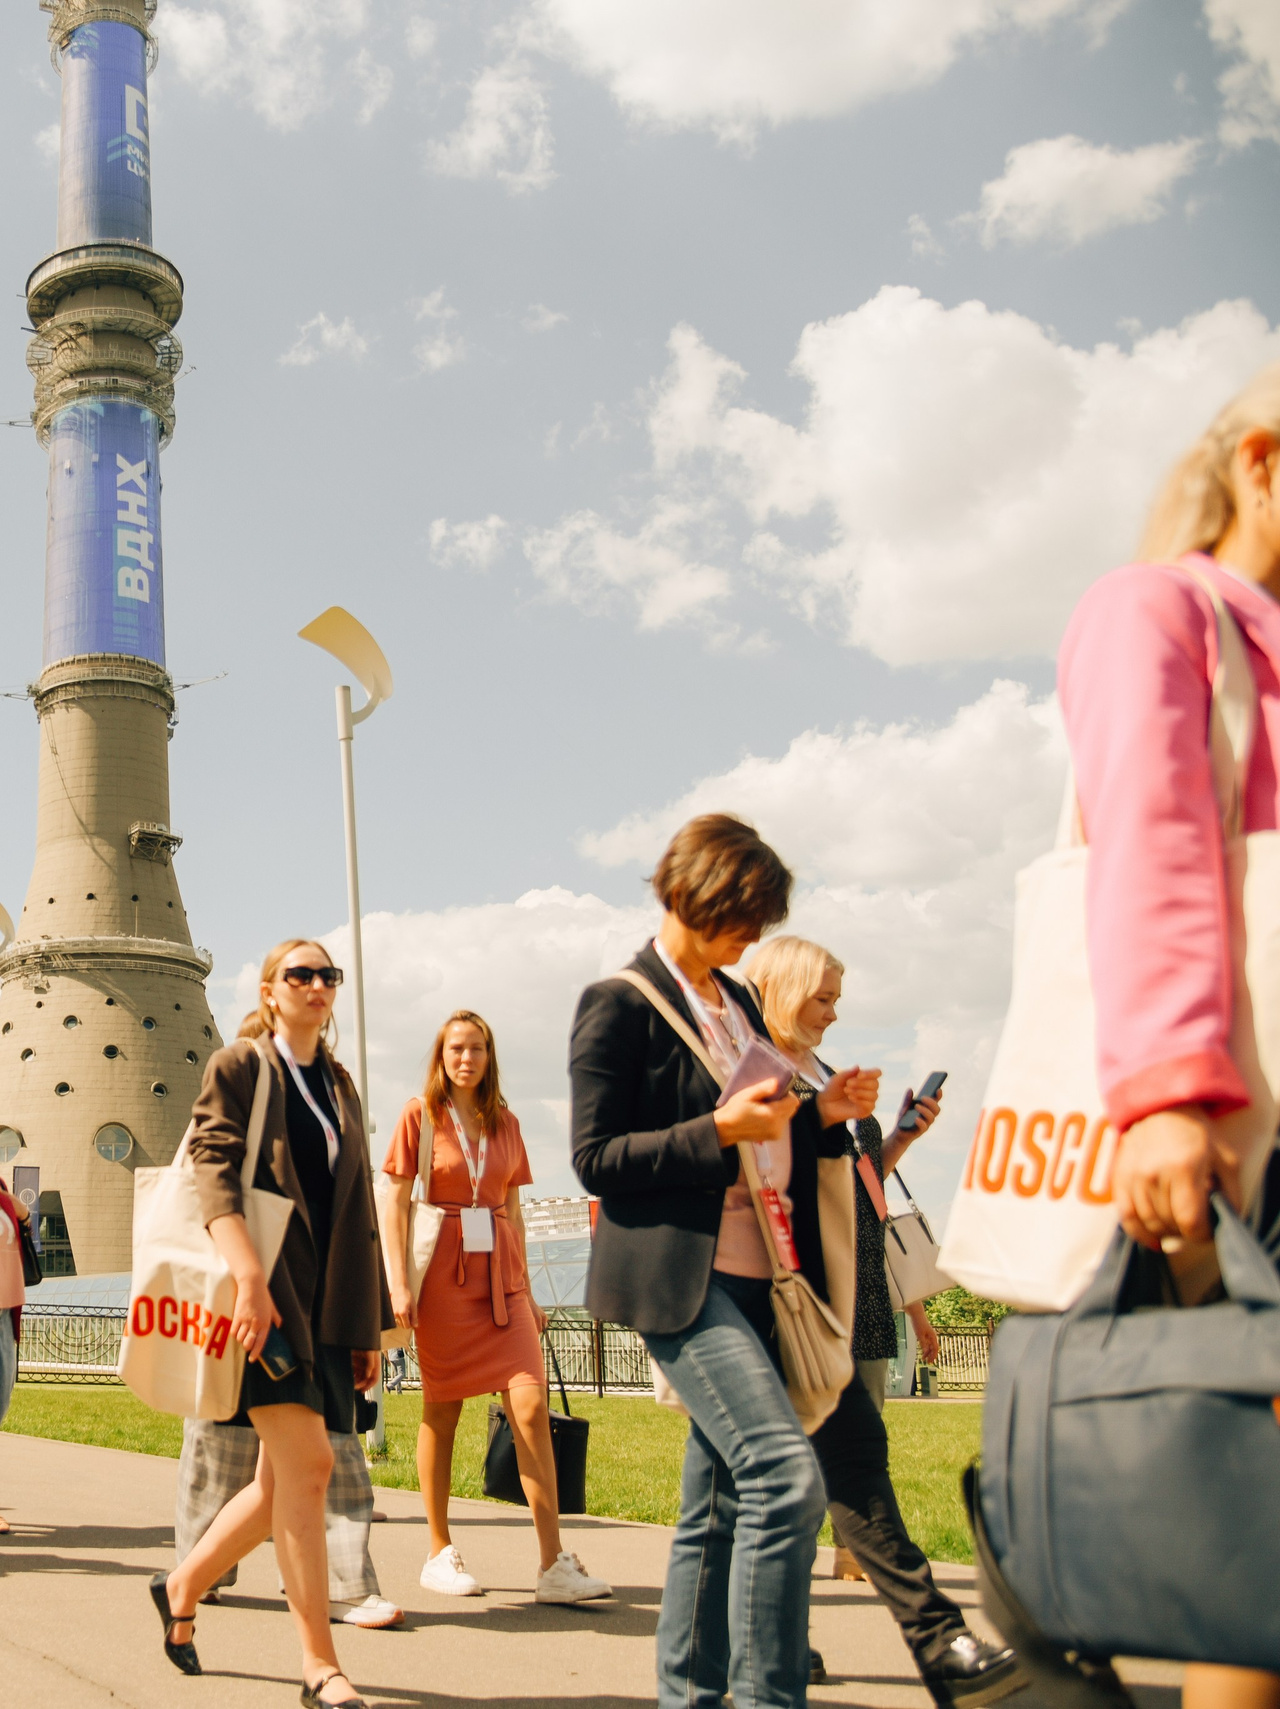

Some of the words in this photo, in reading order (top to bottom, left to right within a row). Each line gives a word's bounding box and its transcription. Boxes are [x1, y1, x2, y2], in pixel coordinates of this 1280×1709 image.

[116, 453, 154, 603] ВДНХ
[964, 1106, 1119, 1206] OSCO
[123, 1295, 233, 1360] ОСКА
